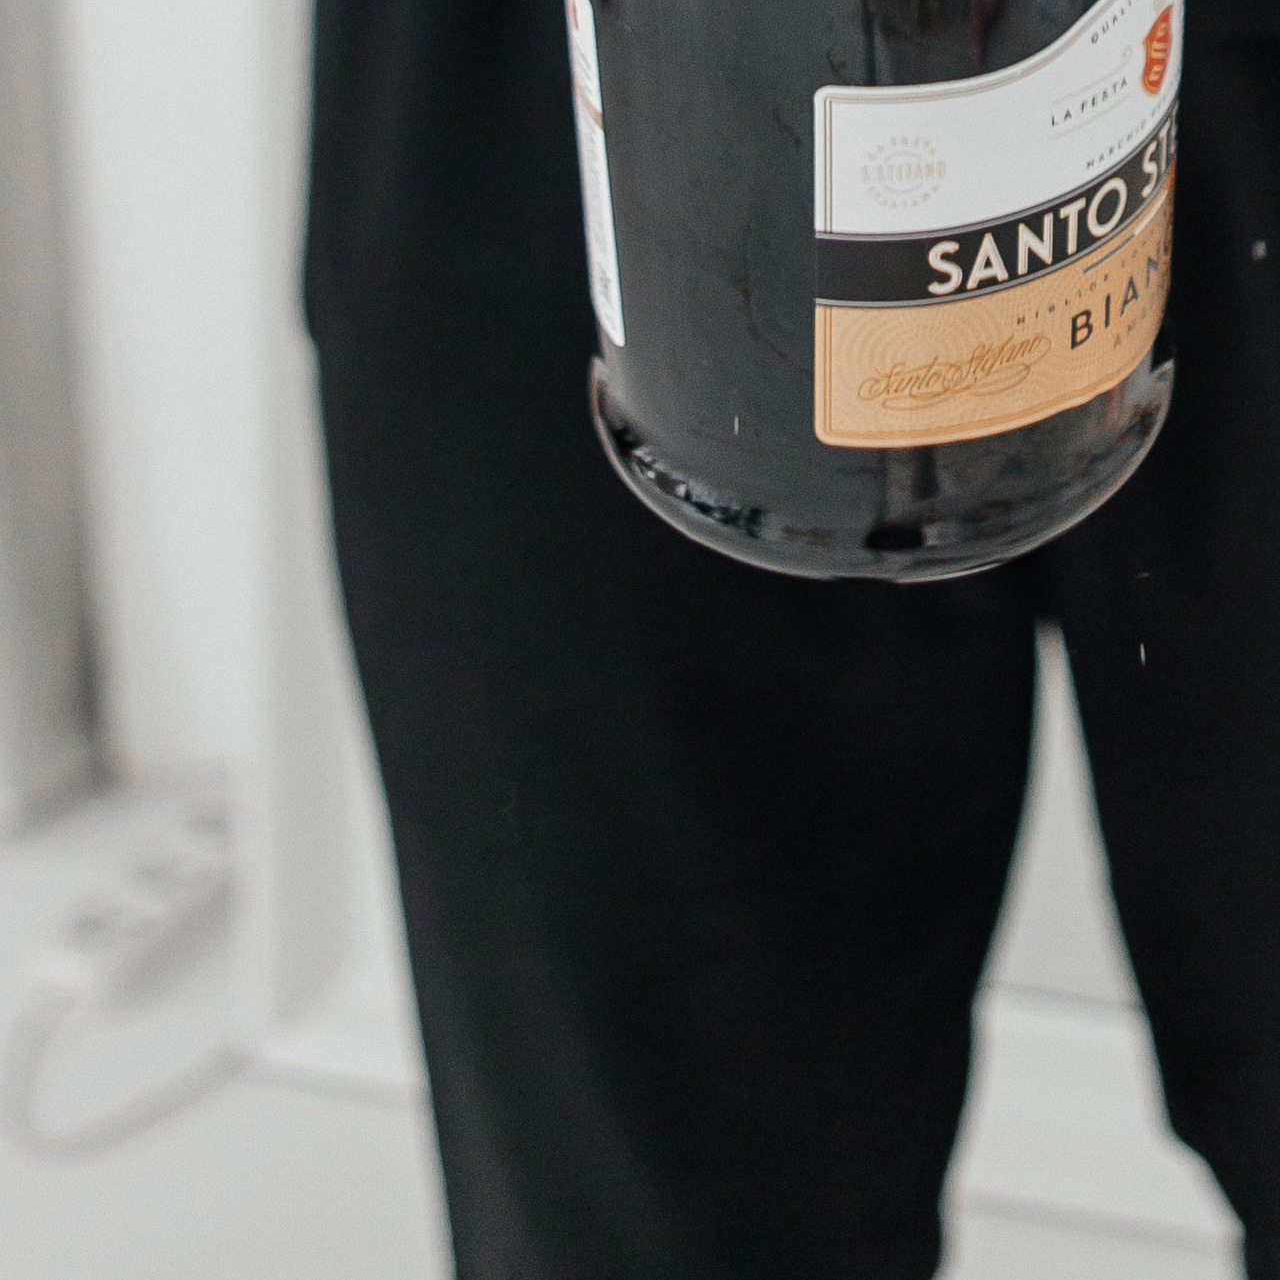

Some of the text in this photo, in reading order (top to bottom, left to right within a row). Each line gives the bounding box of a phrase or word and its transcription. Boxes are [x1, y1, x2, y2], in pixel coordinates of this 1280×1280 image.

[1050, 108, 1074, 128] LA
[1079, 76, 1129, 114] FESTA
[926, 176, 1128, 298] SANTO
